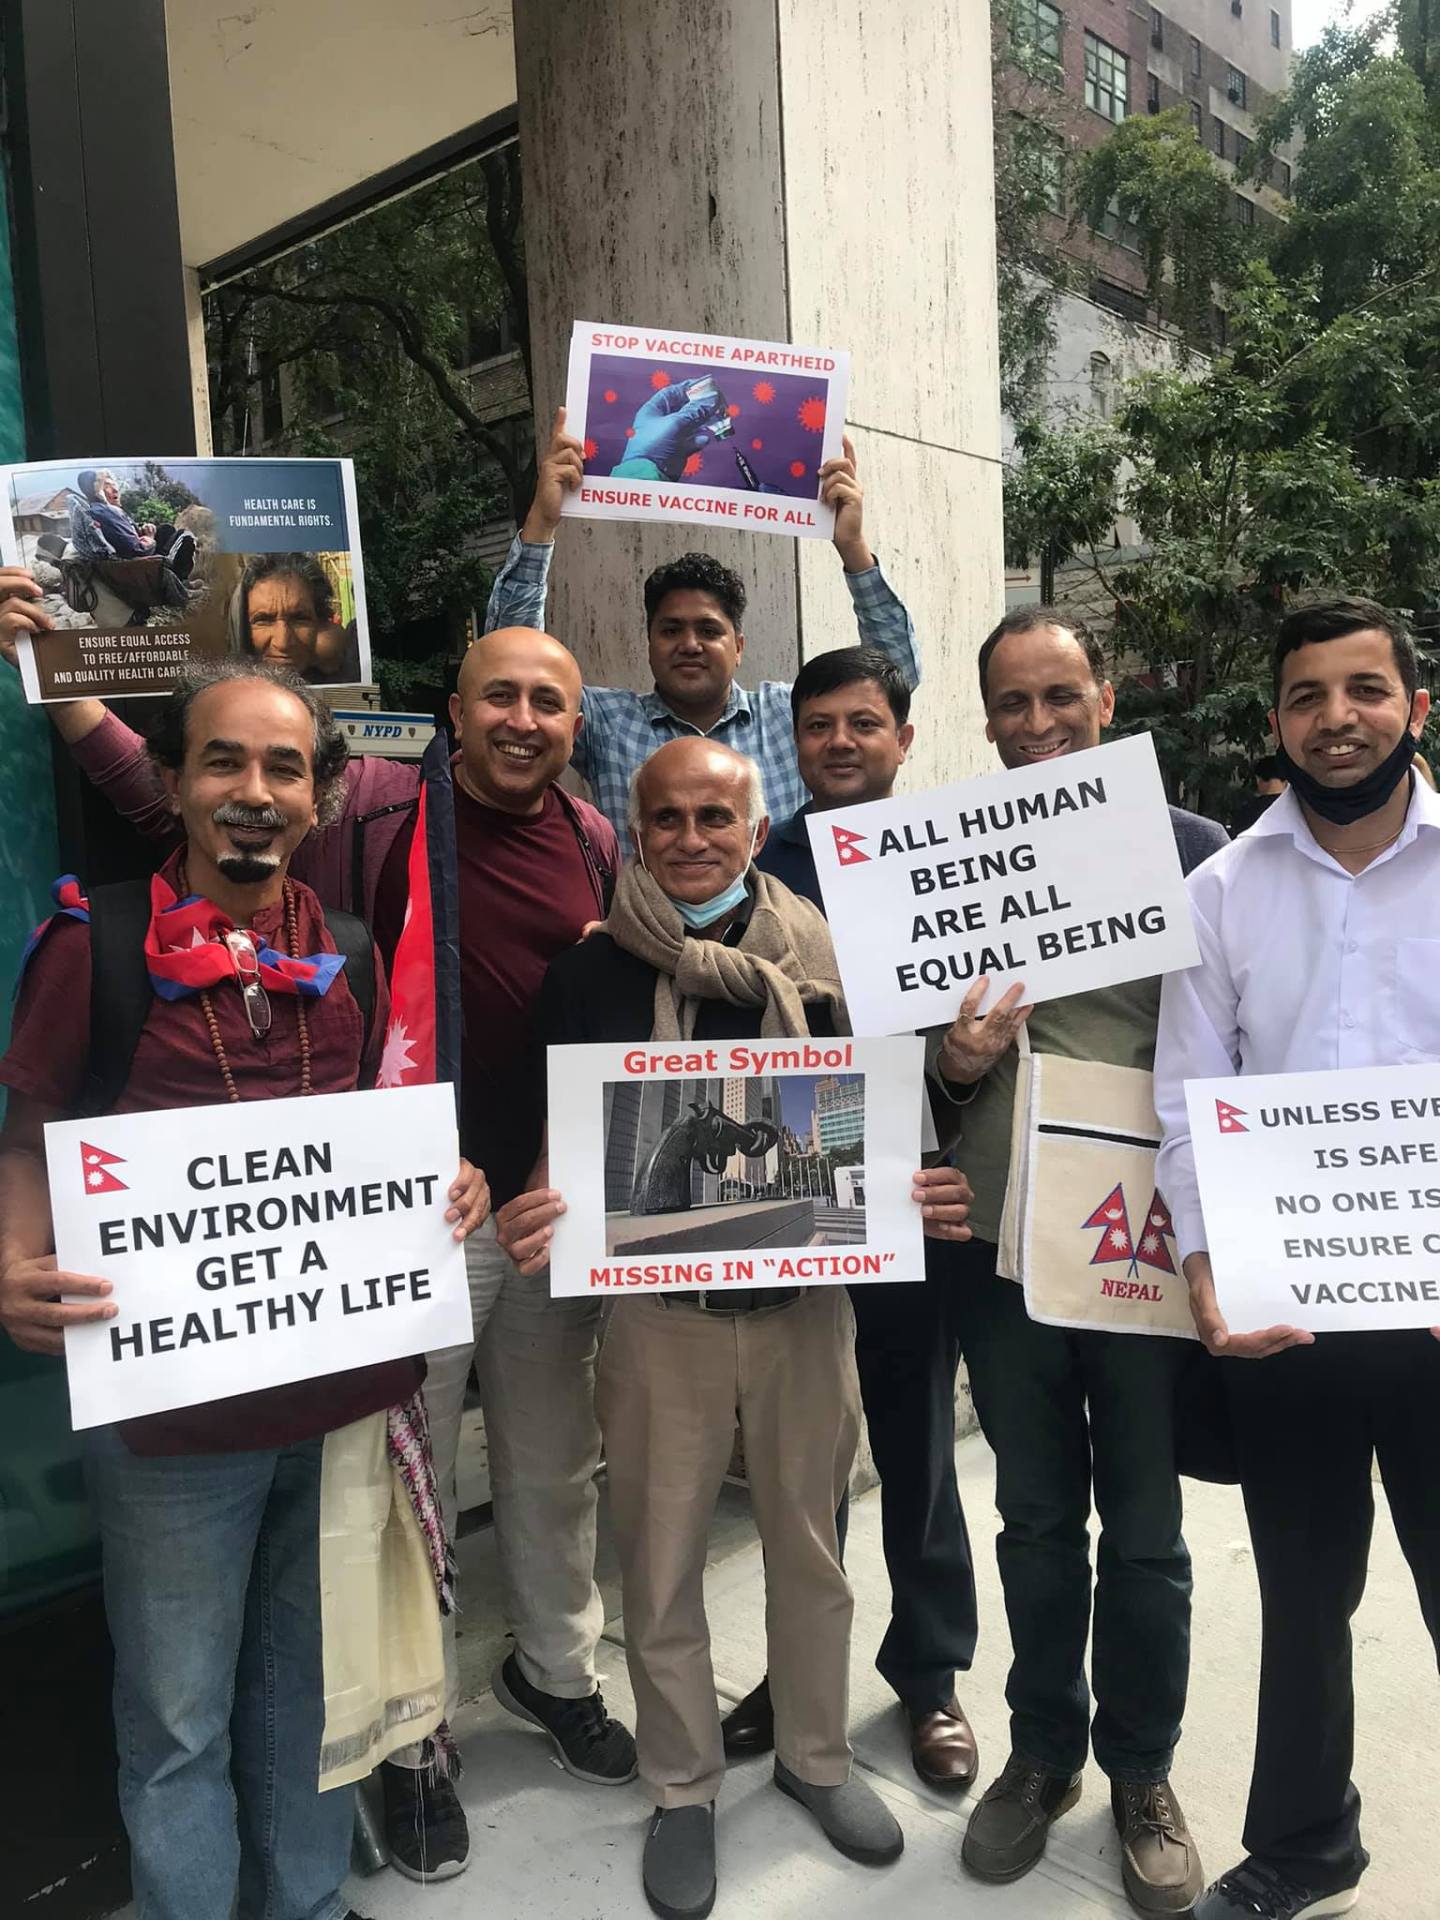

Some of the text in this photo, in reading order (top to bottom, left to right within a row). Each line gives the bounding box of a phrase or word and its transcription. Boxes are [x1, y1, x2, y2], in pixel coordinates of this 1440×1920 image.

[592, 333, 836, 371] STOP VACCINE APARTHEID
[244, 499, 316, 510] HEALTH CARE IS
[581, 489, 816, 526] ENSURE VACCINE FOR ALL
[229, 515, 334, 526] FUNDAMENTAL RIGHTS.
[79, 633, 191, 648] ENSURE EQUAL ACCESS
[83, 650, 189, 665] TO FREE/AFFORDABLE
[54, 671, 73, 684] AND
[75, 669, 115, 682] QUALITY
[118, 667, 154, 680] HEALTH
[157, 666, 182, 678] CARE
[363, 725, 402, 738] NYPD
[879, 777, 1107, 857] ALL HUMAN
[910, 844, 1037, 896] BEING
[910, 885, 1072, 943] ARE ALL
[896, 905, 1167, 992] EQUAL BEING
[623, 1044, 852, 1075] Great Symbol
[1260, 1101, 1381, 1128] UNLESS
[186, 1142, 333, 1191] CLEAN
[1314, 1143, 1438, 1169] IS SAFE
[99, 1174, 439, 1256] ENVIRONMENT
[1275, 1188, 1440, 1215] NO ONE IS
[1284, 1235, 1412, 1259] ENSURE
[196, 1240, 328, 1291] GET A
[590, 1253, 896, 1287] MISSING IN “ACTION”
[1100, 1278, 1163, 1302] NEPAL
[1291, 1281, 1439, 1305] VACCINE
[110, 1268, 432, 1361] HEALTHY LIFE
